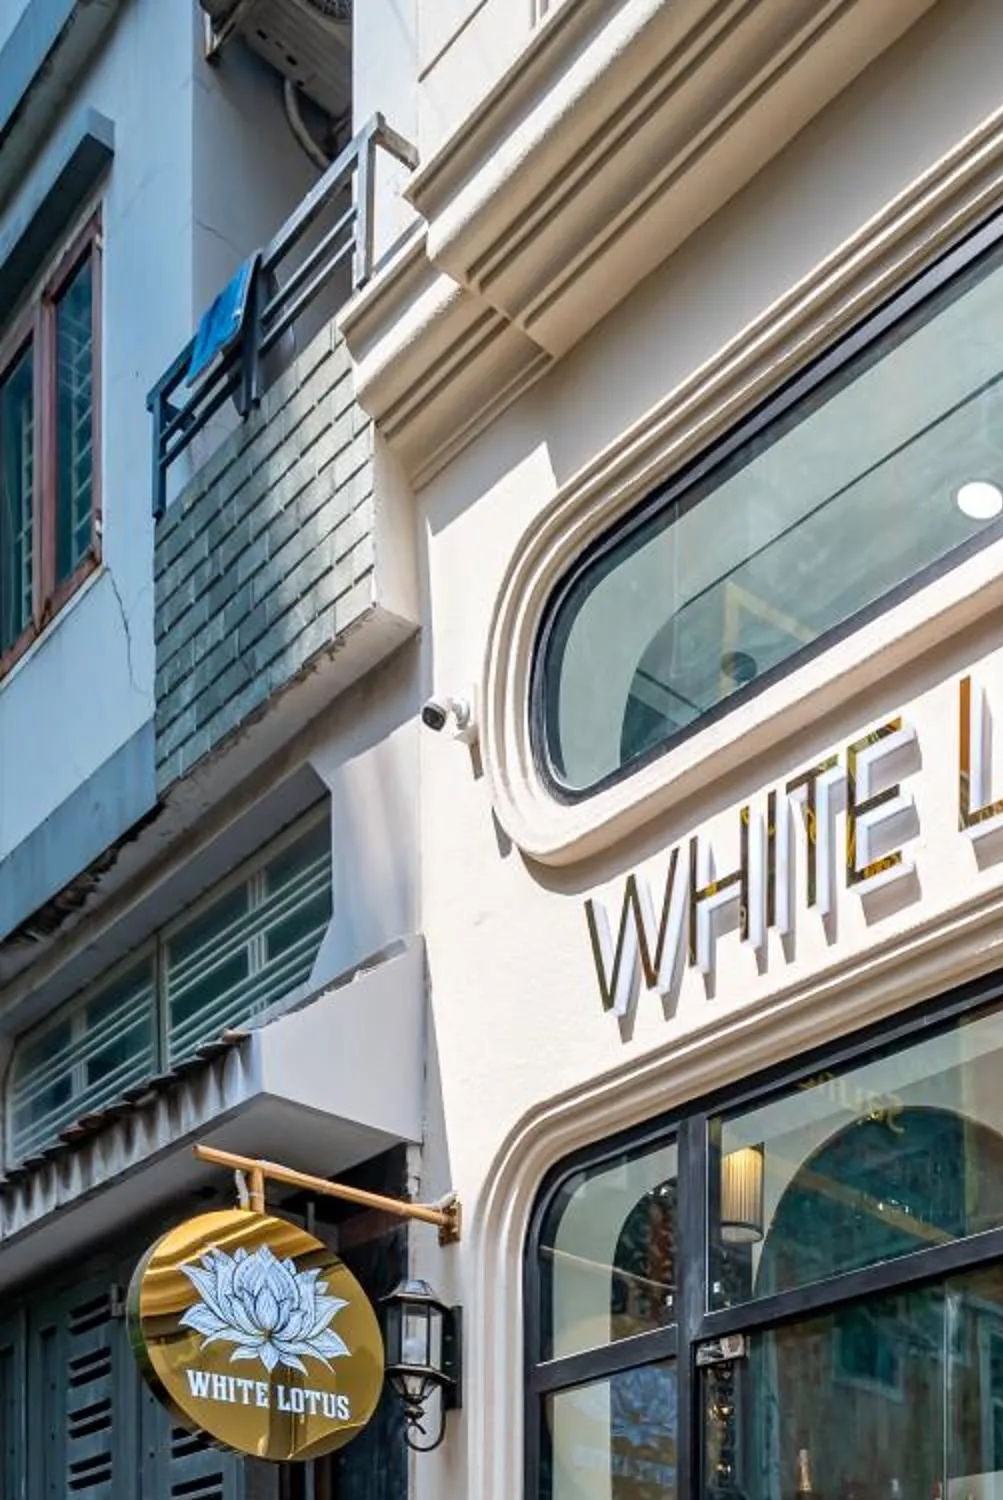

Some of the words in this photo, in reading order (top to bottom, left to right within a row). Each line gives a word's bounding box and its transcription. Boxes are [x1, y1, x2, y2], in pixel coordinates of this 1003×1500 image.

[584, 716, 914, 1016] WHITE
[186, 1369, 269, 1409] WHITE
[277, 1385, 350, 1421] LOTUS
